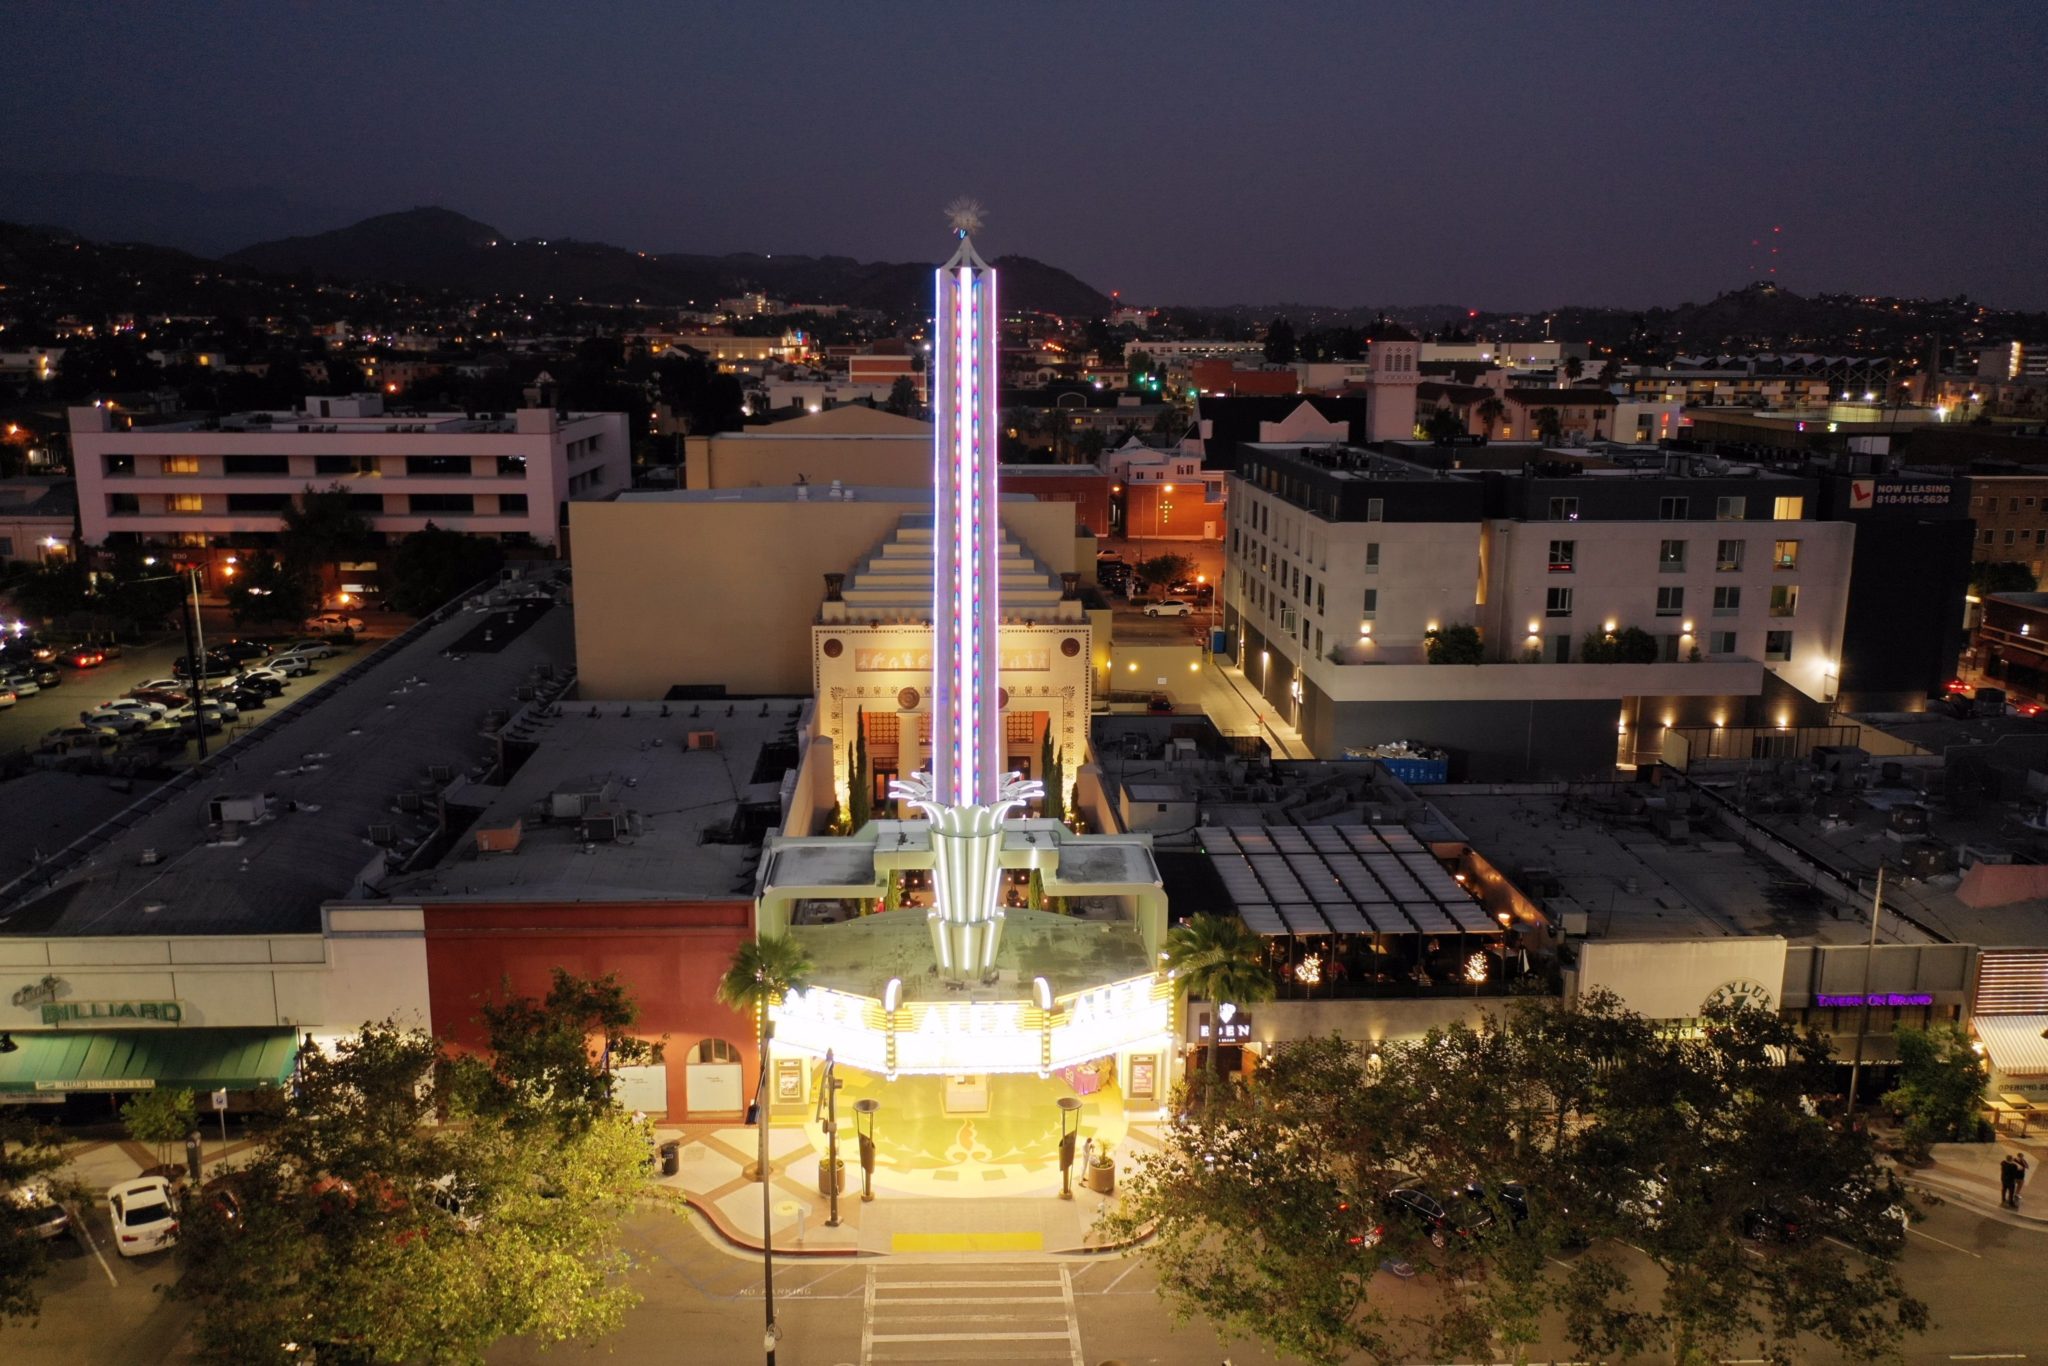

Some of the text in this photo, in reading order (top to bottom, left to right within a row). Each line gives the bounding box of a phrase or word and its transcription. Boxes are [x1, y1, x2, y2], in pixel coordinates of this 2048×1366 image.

[1876, 495, 1949, 504] 818-916-5624
[1878, 484, 1951, 494] NOW LEASING
[1707, 982, 1773, 1009] STYLUX
[41, 1001, 183, 1025] BILLIARD
[918, 1004, 1020, 1033] ALEX
